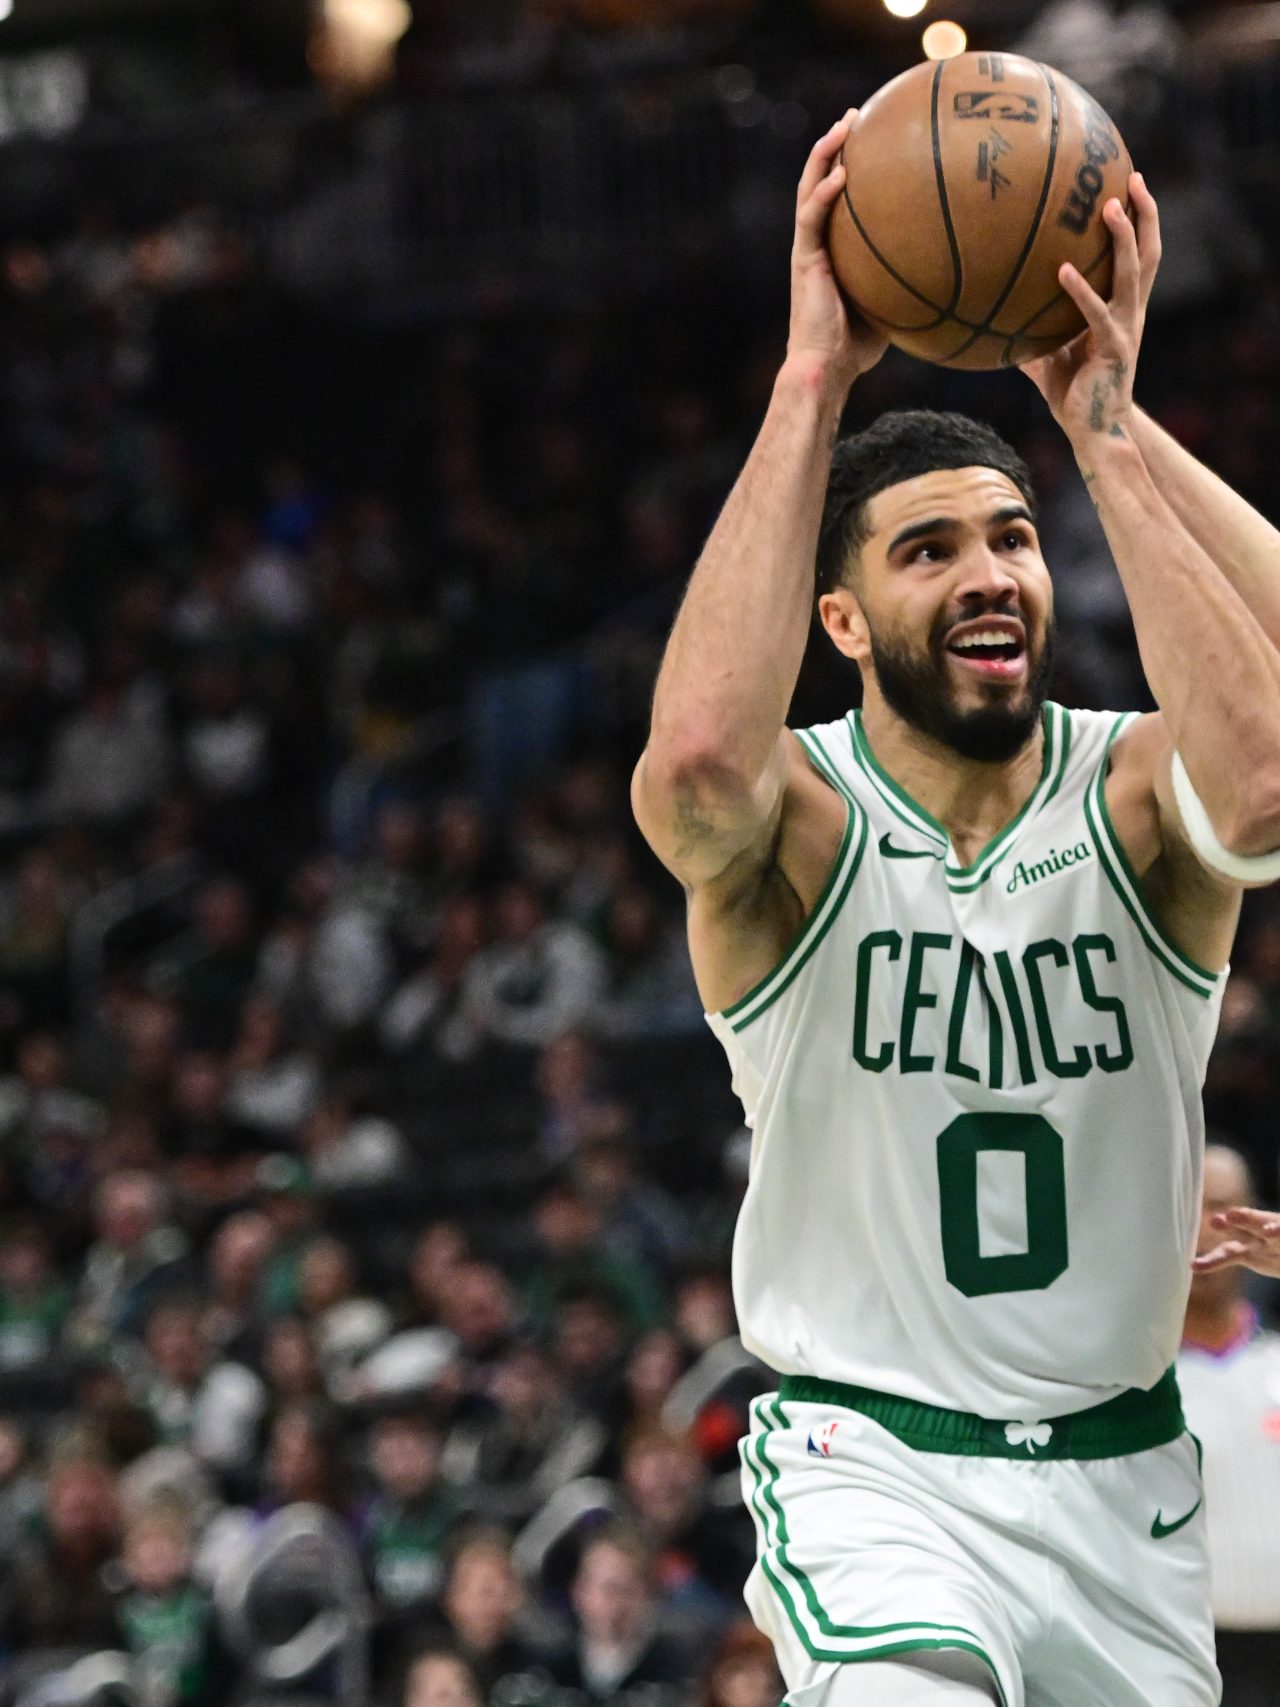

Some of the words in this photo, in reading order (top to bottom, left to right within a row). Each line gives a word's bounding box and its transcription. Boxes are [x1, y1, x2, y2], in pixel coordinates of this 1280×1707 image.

[1006, 842, 1091, 893] Amica
[853, 929, 1134, 1090] CELTICS
[936, 1111, 1069, 1298] 0
